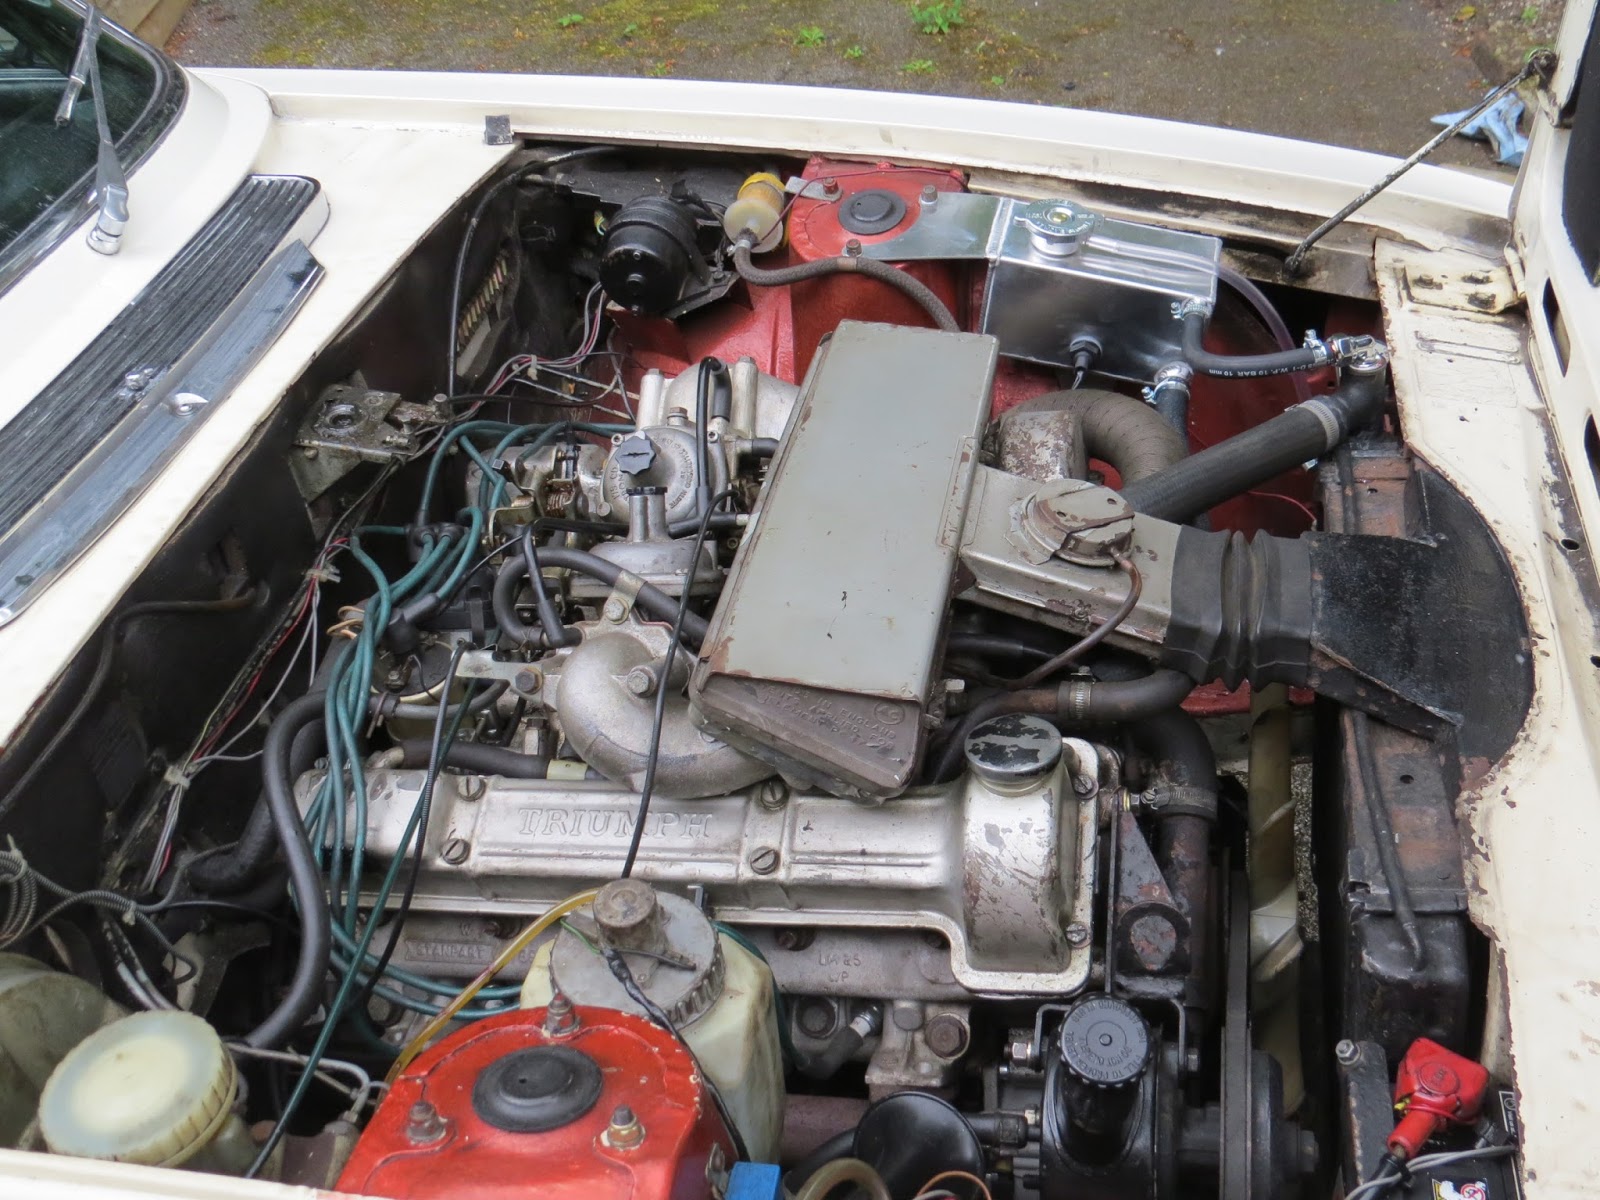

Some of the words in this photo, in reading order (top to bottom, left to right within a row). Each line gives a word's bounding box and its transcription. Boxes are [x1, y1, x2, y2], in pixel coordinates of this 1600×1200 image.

[1271, 367, 1288, 375] W.P.
[840, 707, 897, 740] ENGLAND
[518, 807, 713, 839] TRIUMPH
[1077, 1059, 1109, 1080] PROPER
[1124, 1054, 1143, 1072] FILL
[1113, 1069, 1125, 1079] TO
